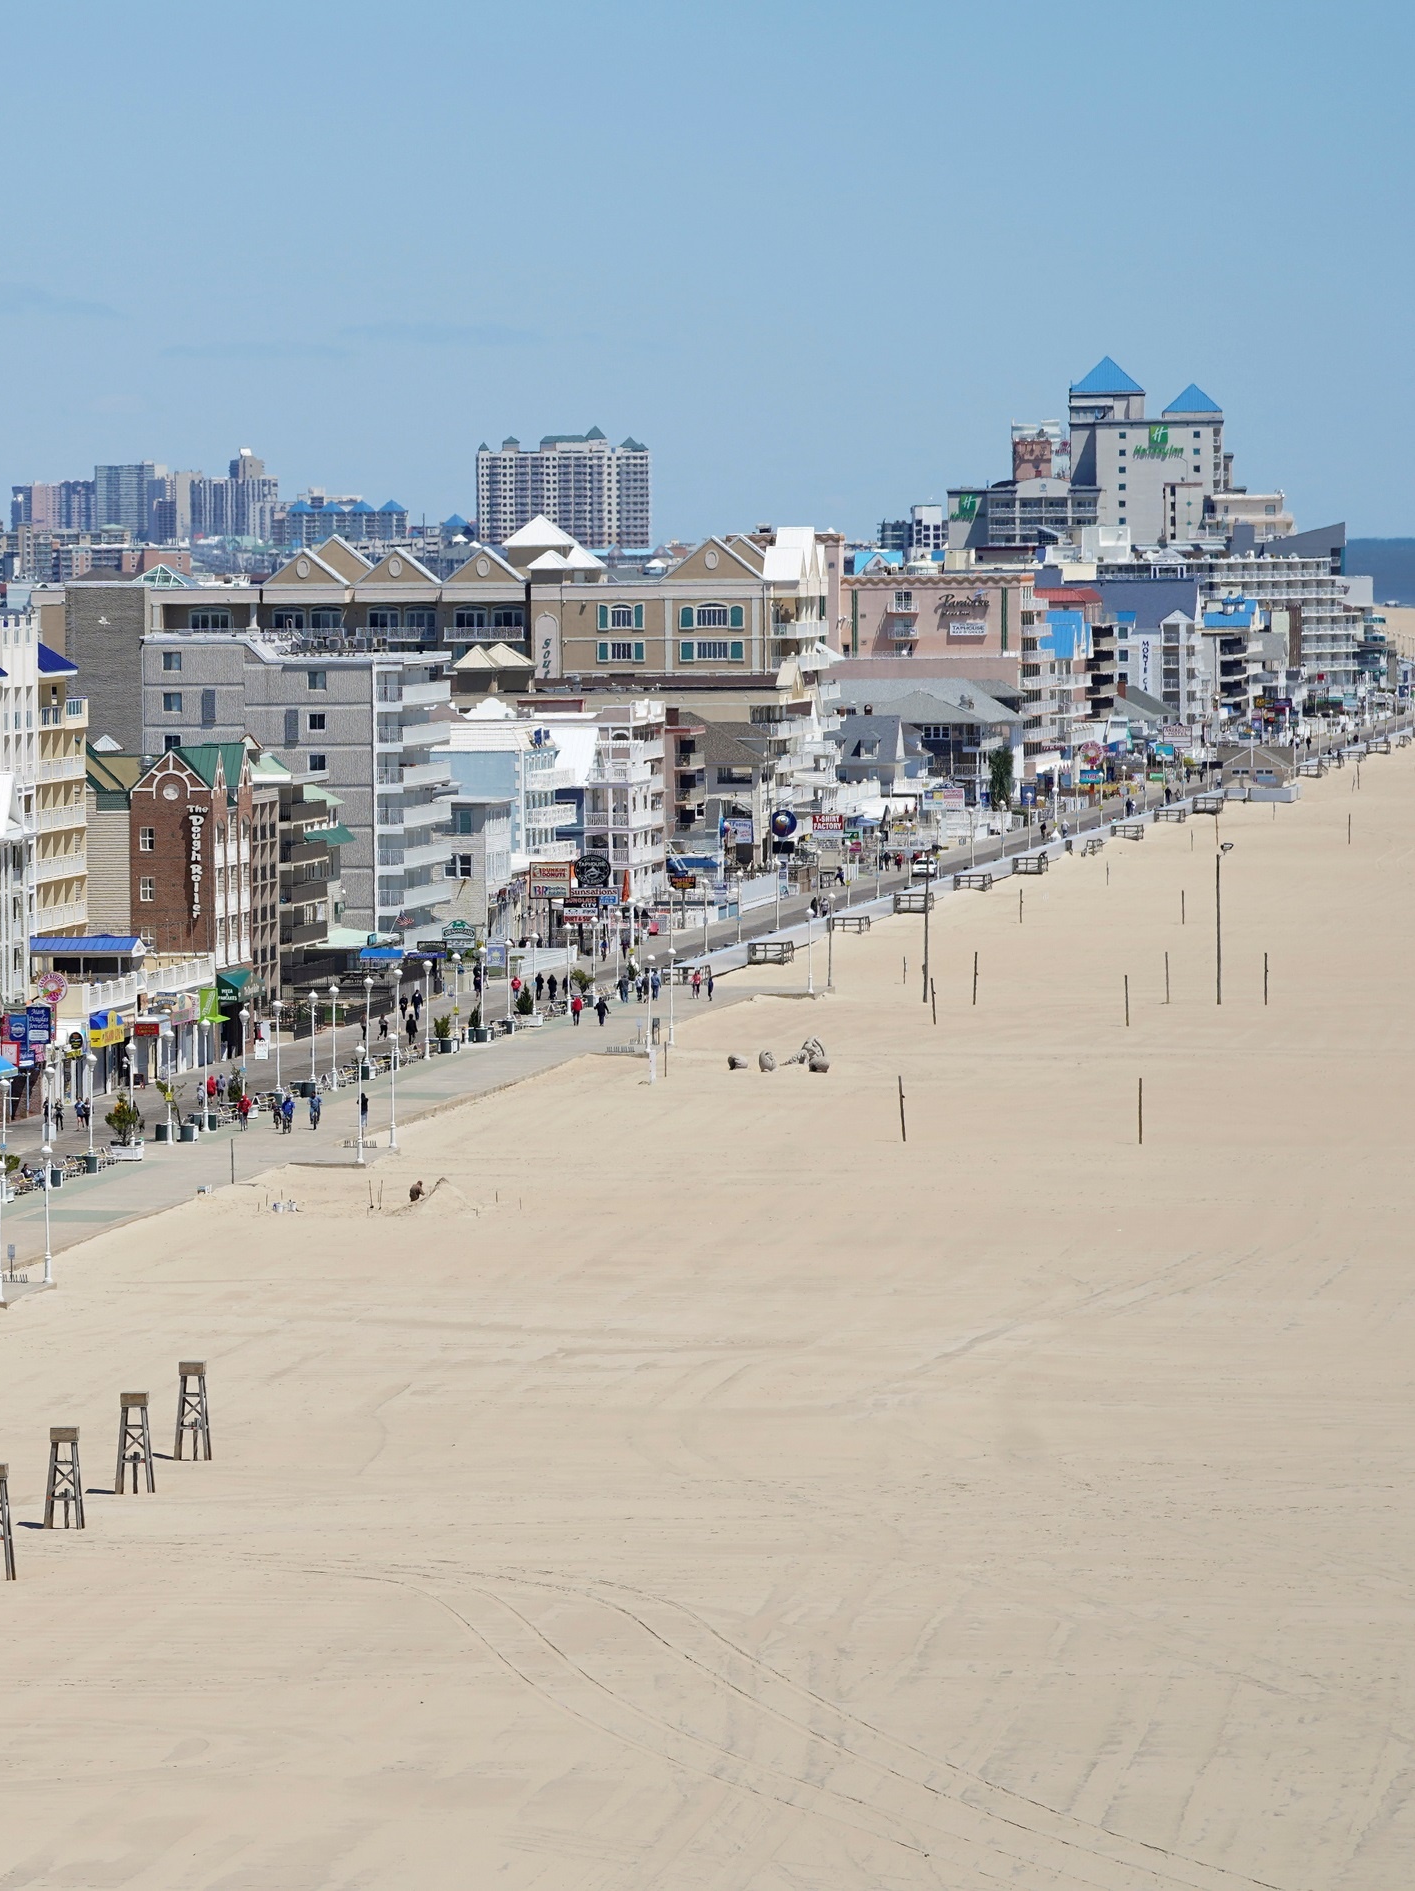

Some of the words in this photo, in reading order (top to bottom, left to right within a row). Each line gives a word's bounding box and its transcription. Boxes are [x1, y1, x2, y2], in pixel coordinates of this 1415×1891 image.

[938, 594, 990, 607] Paradise
[1142, 640, 1150, 674] MONTE
[186, 804, 209, 813] The
[189, 815, 204, 861] Dough
[190, 864, 203, 919] Roller
[571, 888, 618, 896] Sunsations
